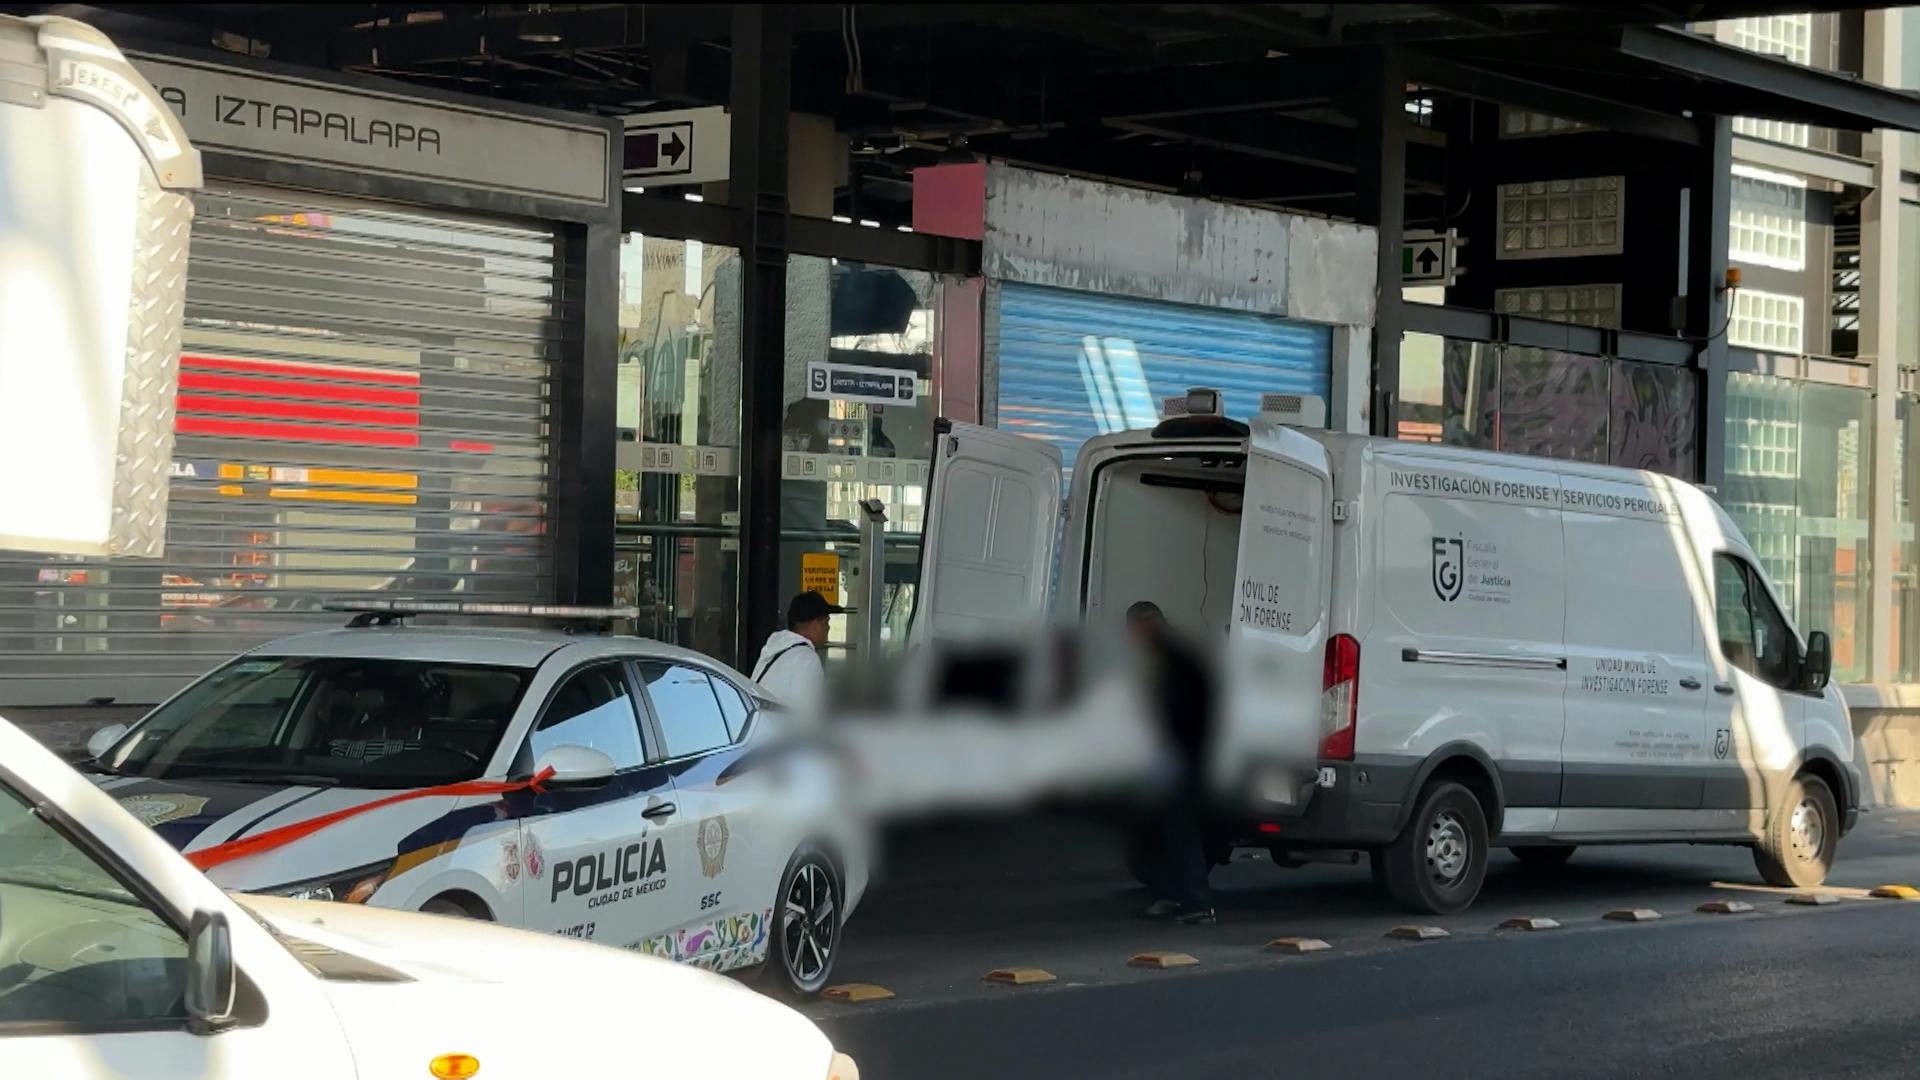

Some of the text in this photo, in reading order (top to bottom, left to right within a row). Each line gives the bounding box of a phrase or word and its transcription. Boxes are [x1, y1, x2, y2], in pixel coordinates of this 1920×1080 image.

[216, 95, 441, 154] IZTAPALAPA
[814, 370, 825, 388] 5
[1390, 471, 1679, 516] INVESTIGACIÓN FORENSE Y SERVICIOS PERICIALE
[1480, 574, 1511, 588] Justicia
[1268, 585, 1280, 604] DE
[1254, 607, 1292, 631] FORENSE
[551, 827, 667, 903] POLICÍA
[588, 878, 666, 909] CIUDAD DE MÉXICO
[700, 890, 722, 910] SSC
